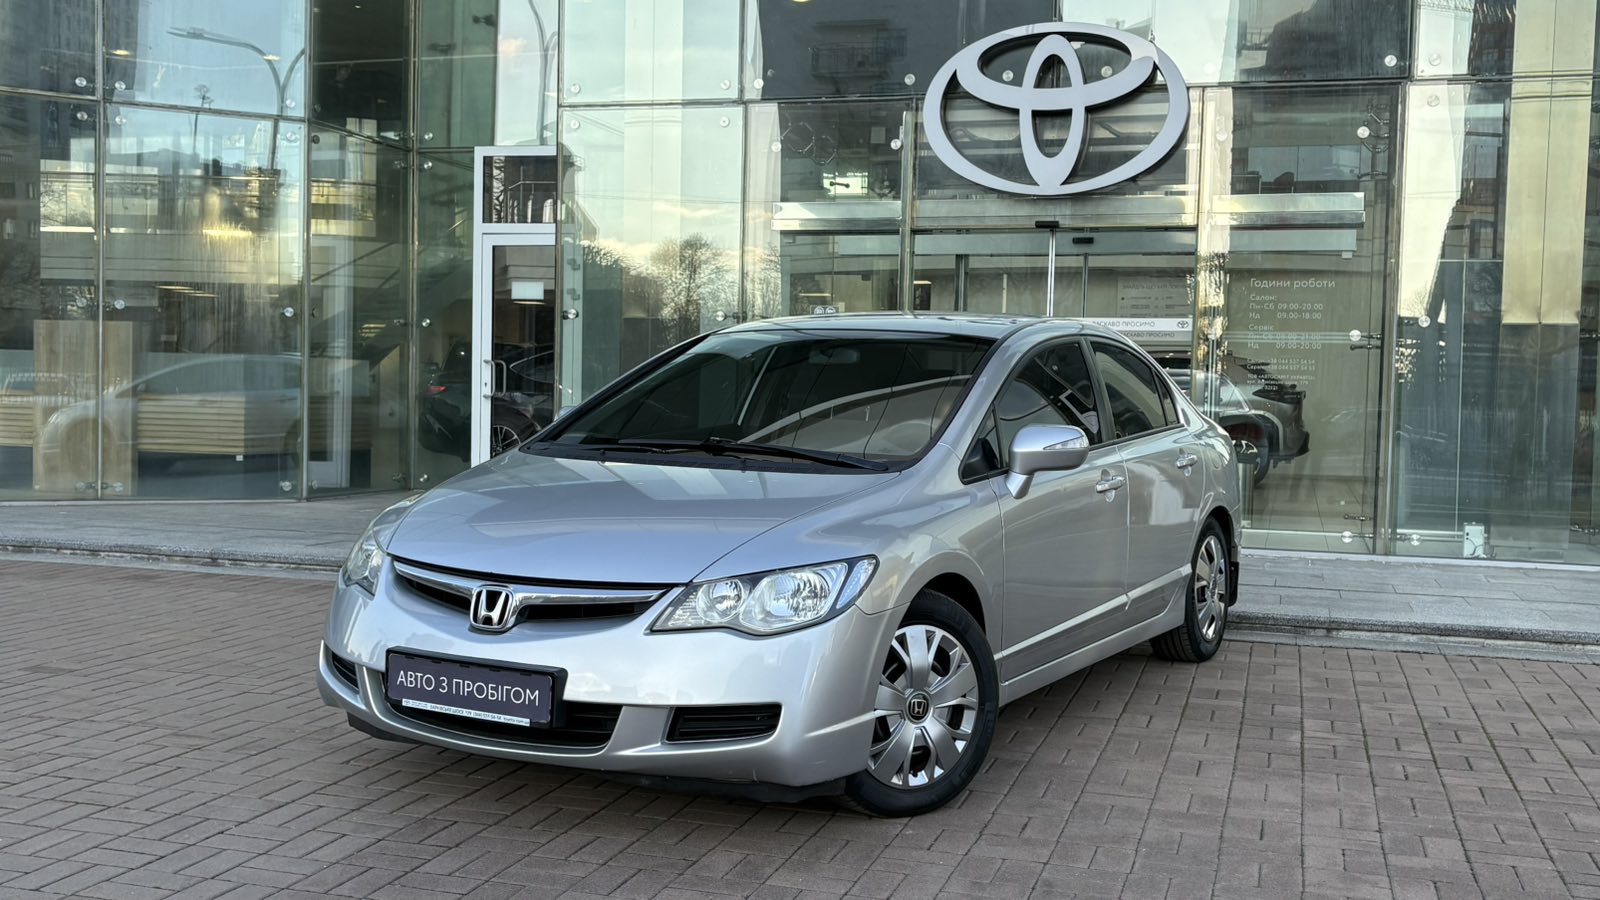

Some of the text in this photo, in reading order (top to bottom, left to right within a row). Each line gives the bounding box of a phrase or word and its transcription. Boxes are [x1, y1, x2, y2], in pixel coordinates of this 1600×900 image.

[1250, 278, 1336, 290] Години роботи
[1249, 312, 1261, 320] Нд
[1247, 341, 1259, 349] Нд
[397, 670, 435, 691] АВТО
[452, 679, 539, 707] ПРОБІГОМ
